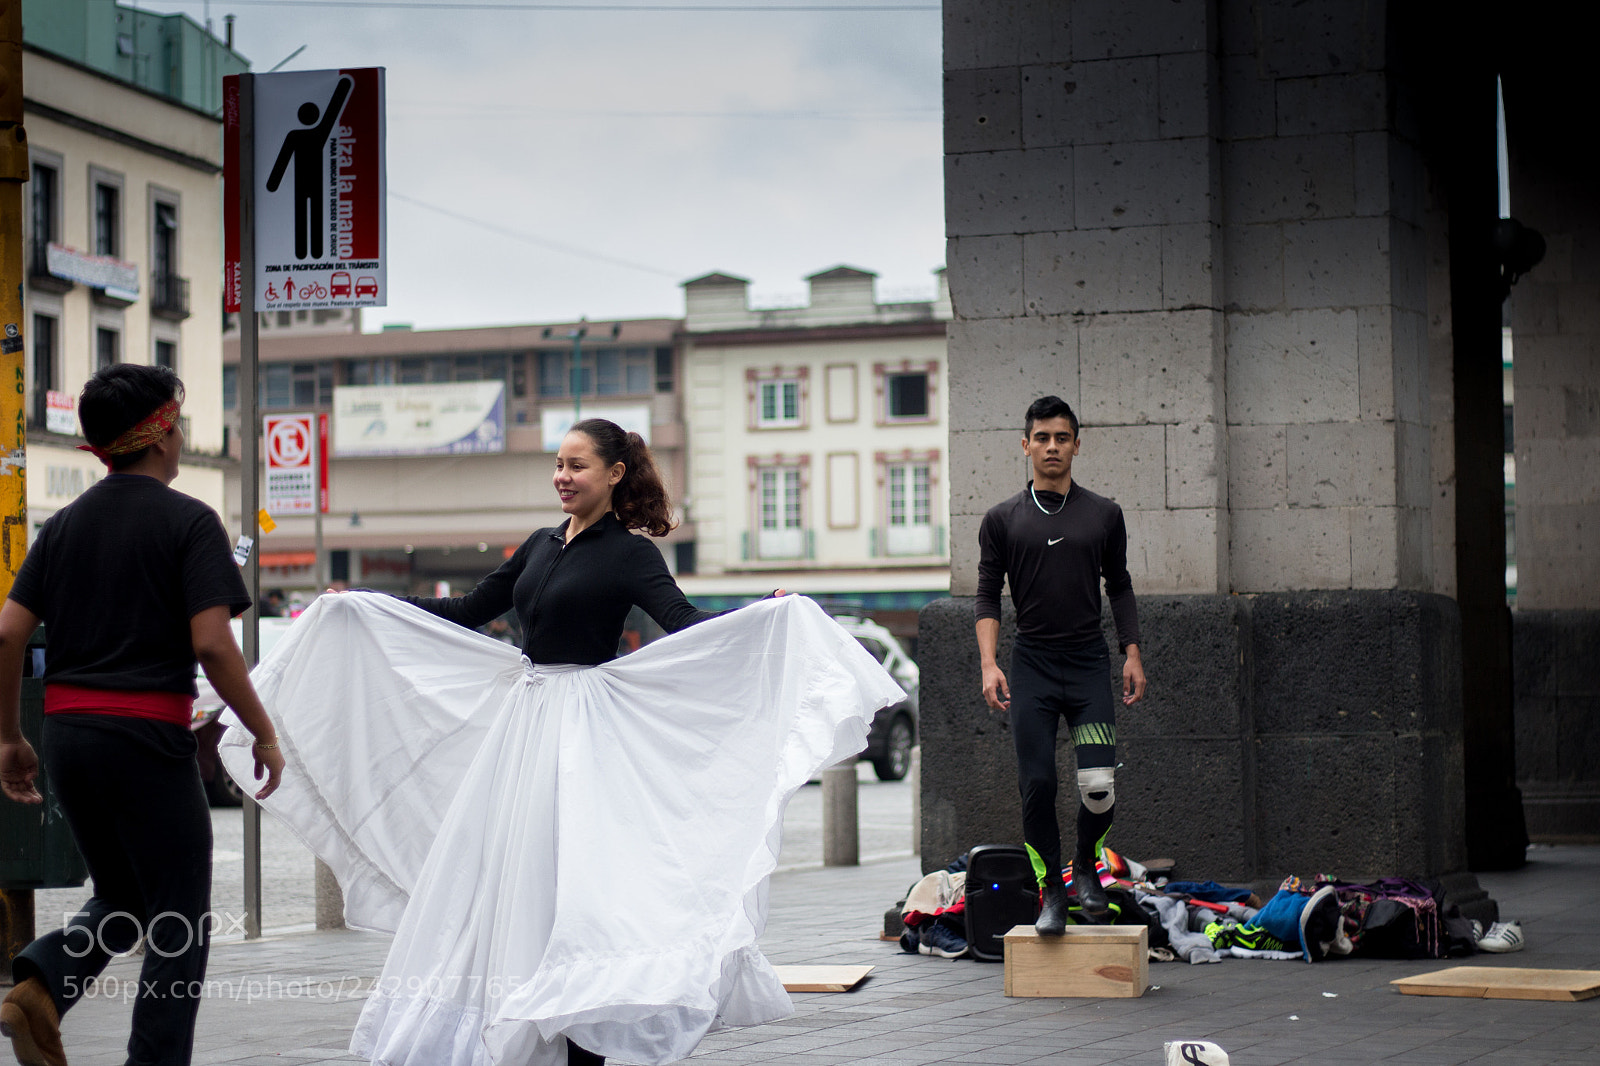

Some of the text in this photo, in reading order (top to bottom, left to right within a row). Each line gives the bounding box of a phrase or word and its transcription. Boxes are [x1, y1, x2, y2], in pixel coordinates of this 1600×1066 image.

[330, 187, 337, 197] TU
[339, 125, 356, 258] alza la mano
[330, 222, 337, 232] DE
[265, 264, 282, 273] ZONA
[283, 264, 291, 272] DE
[292, 262, 334, 271] PACIFICACIÓN
[348, 261, 379, 270] TRÁNSITO
[16, 366, 24, 394] NO
